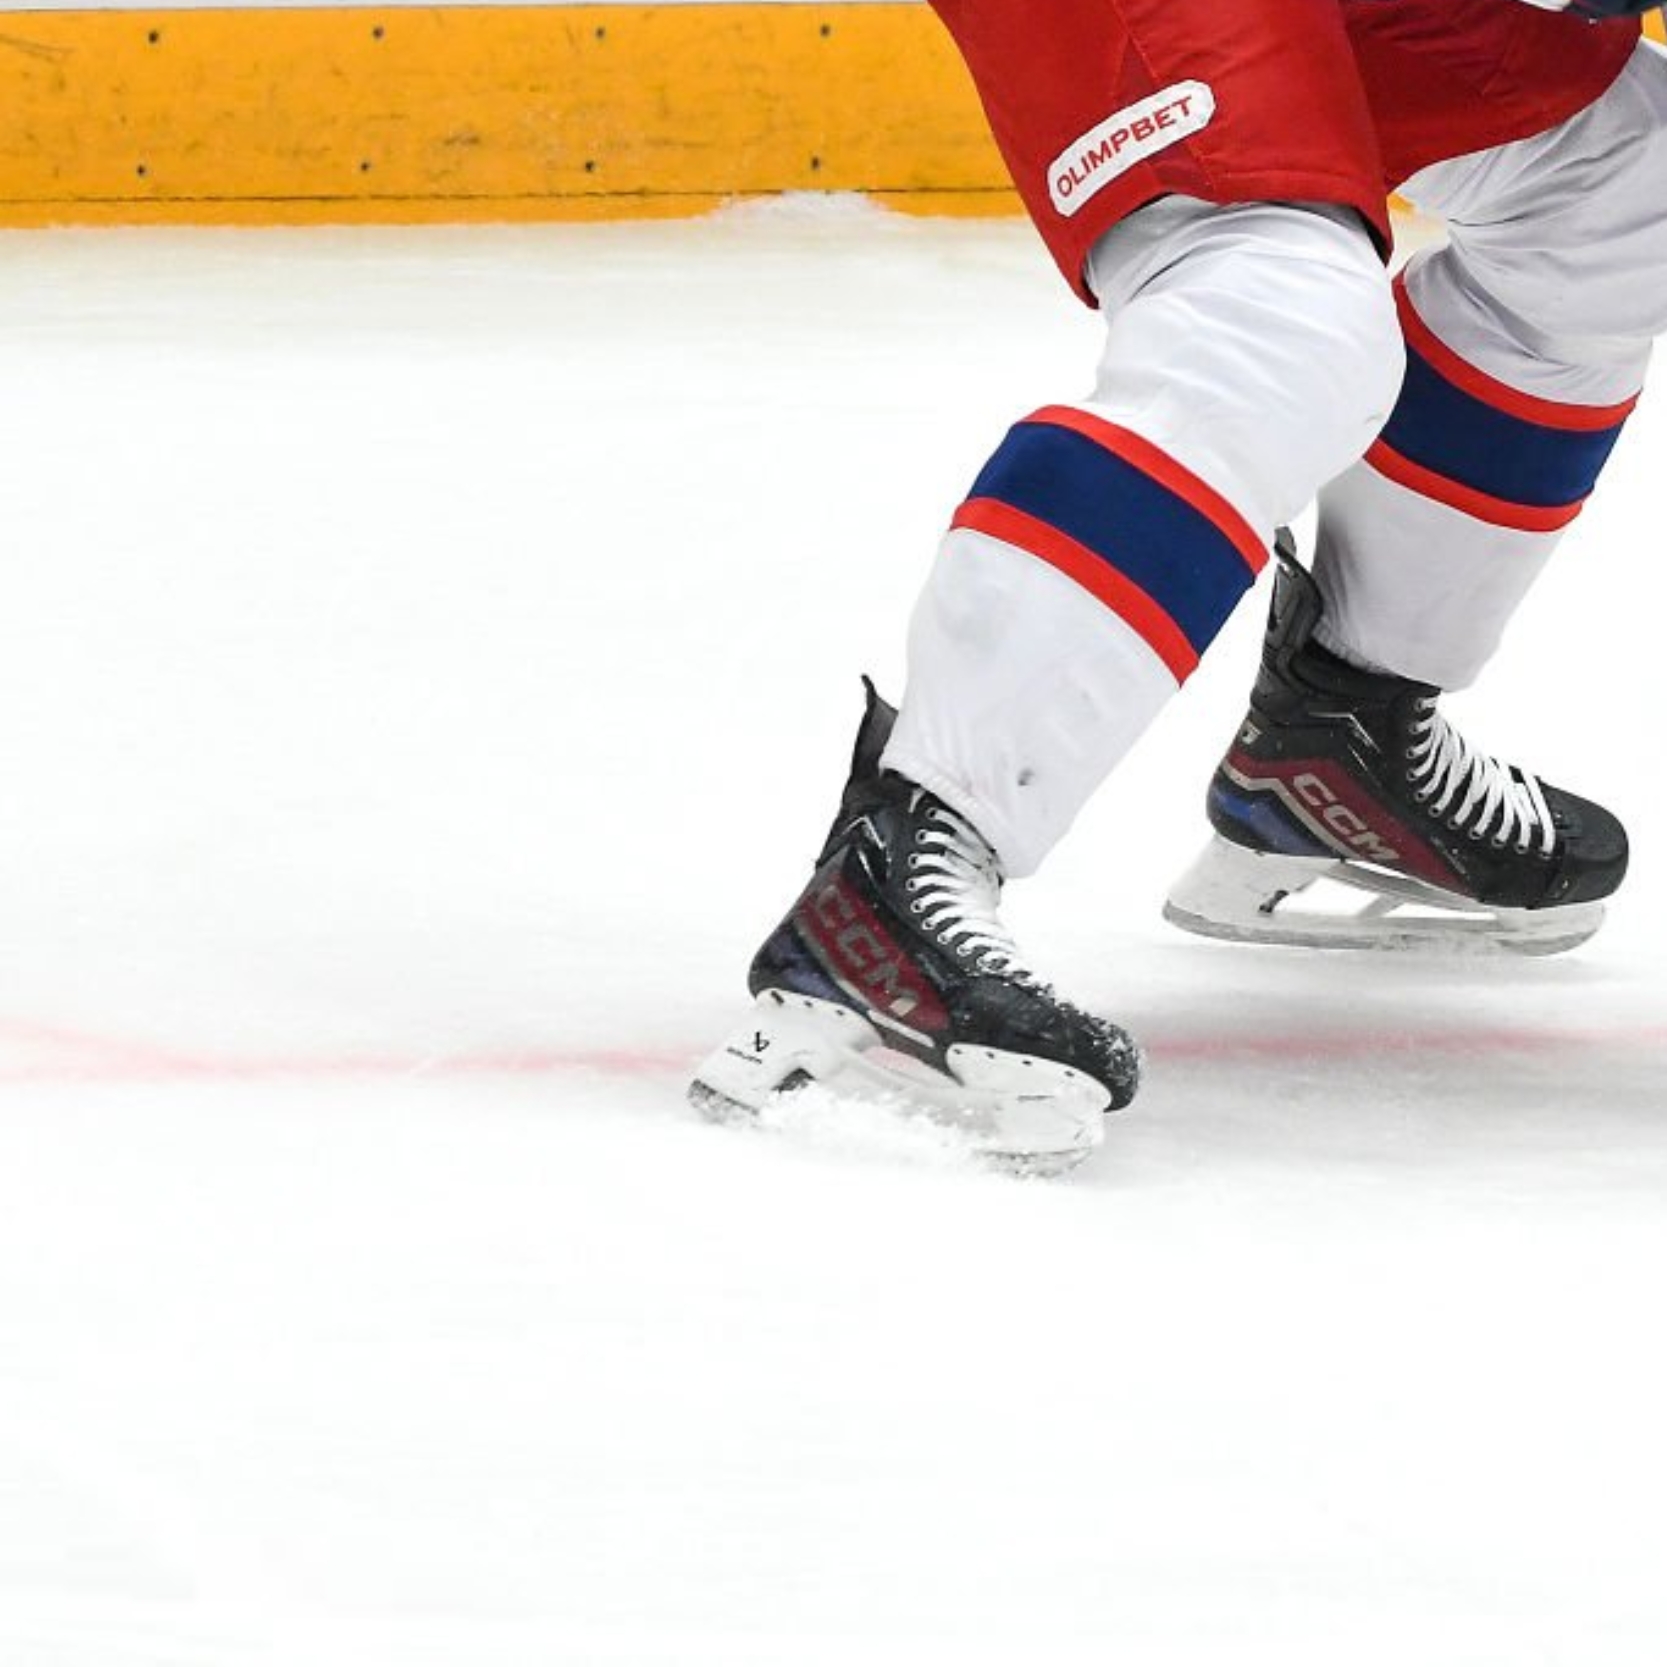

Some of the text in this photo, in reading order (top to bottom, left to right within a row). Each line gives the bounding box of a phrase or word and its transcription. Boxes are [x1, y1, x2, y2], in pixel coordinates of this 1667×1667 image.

[1056, 95, 1193, 198] OLIMPBET
[1294, 772, 1399, 864] CCM
[813, 882, 918, 1018] CCM
